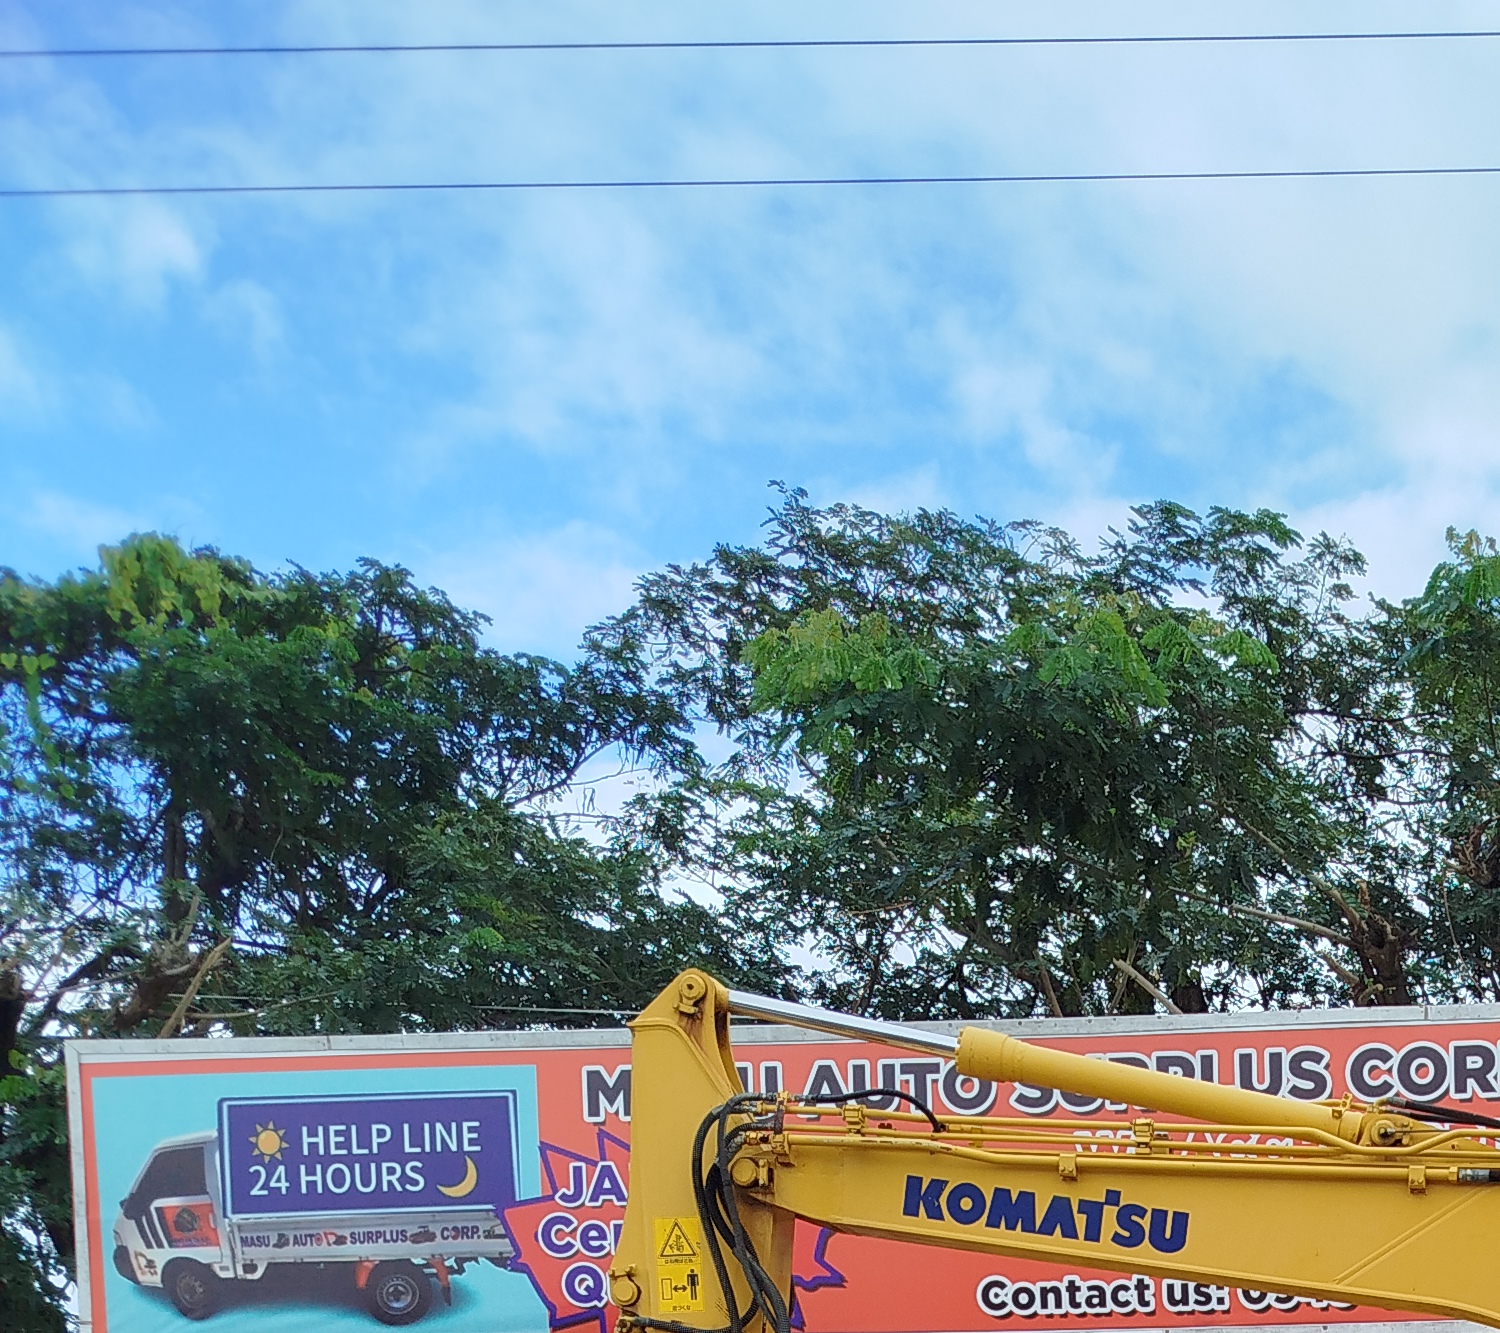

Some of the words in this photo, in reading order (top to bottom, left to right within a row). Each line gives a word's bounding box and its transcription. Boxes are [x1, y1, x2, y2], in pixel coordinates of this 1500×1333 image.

[798, 1058, 996, 1119] AUTO
[302, 1123, 392, 1156] HELP
[403, 1121, 483, 1154] LINE
[249, 1164, 290, 1196] 24
[300, 1161, 425, 1194] HOURS
[903, 1175, 1190, 1254] KOMATSU
[240, 1236, 271, 1248] MASU
[350, 1229, 408, 1245] SURPLUS
[979, 1275, 1154, 1315] Contact
[1163, 1279, 1229, 1310] us:
